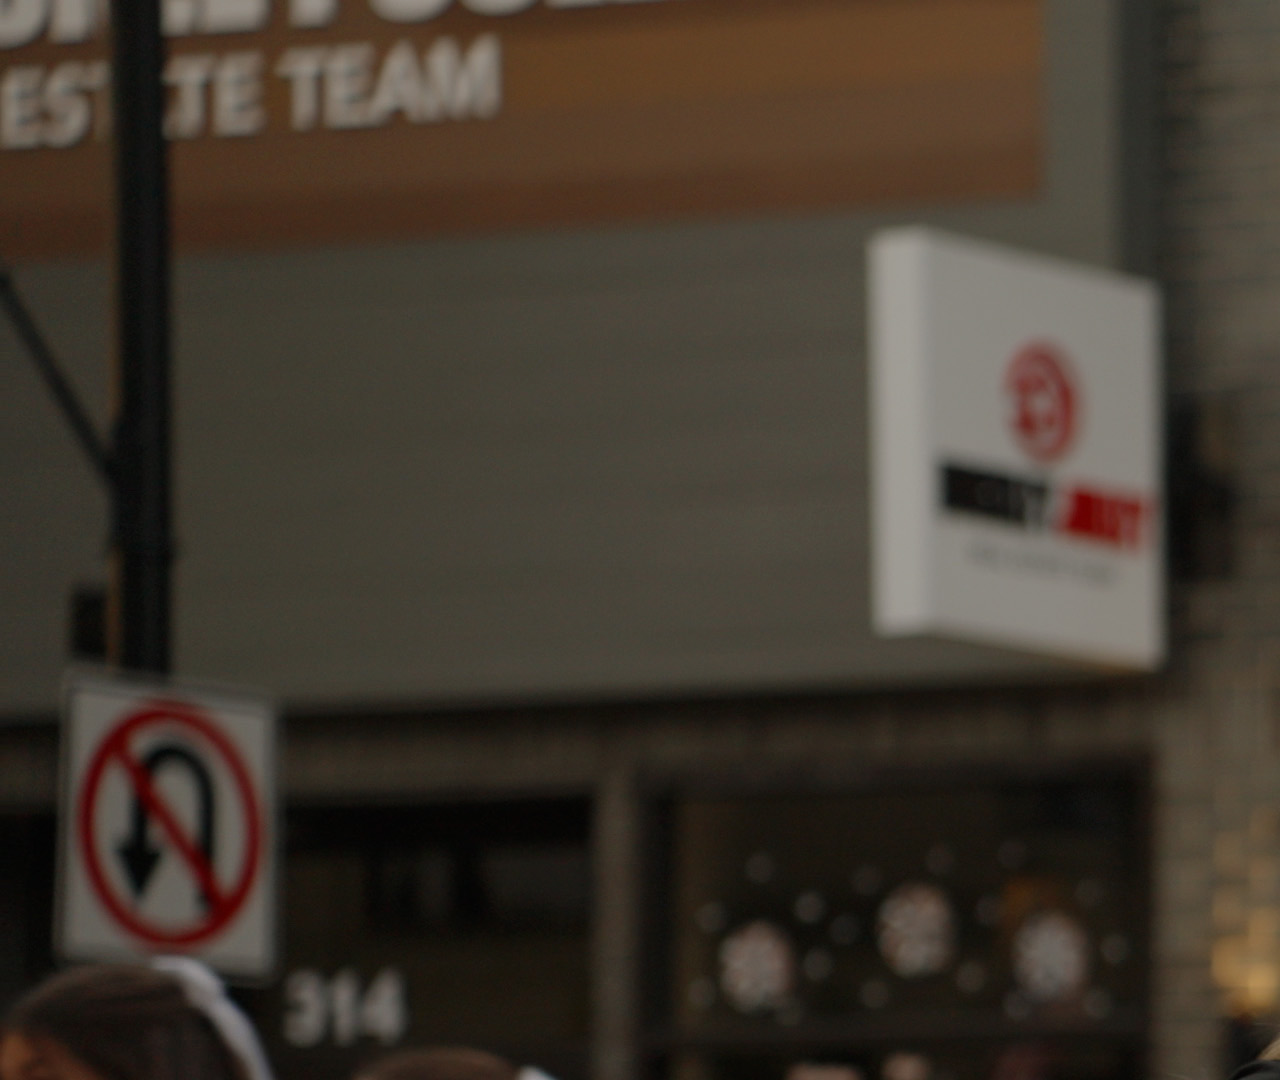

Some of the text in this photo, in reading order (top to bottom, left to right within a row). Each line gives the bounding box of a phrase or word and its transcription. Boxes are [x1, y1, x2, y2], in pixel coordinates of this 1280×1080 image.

[0, 33, 501, 150] ESTTE TEAM
[284, 967, 408, 1047] 314
